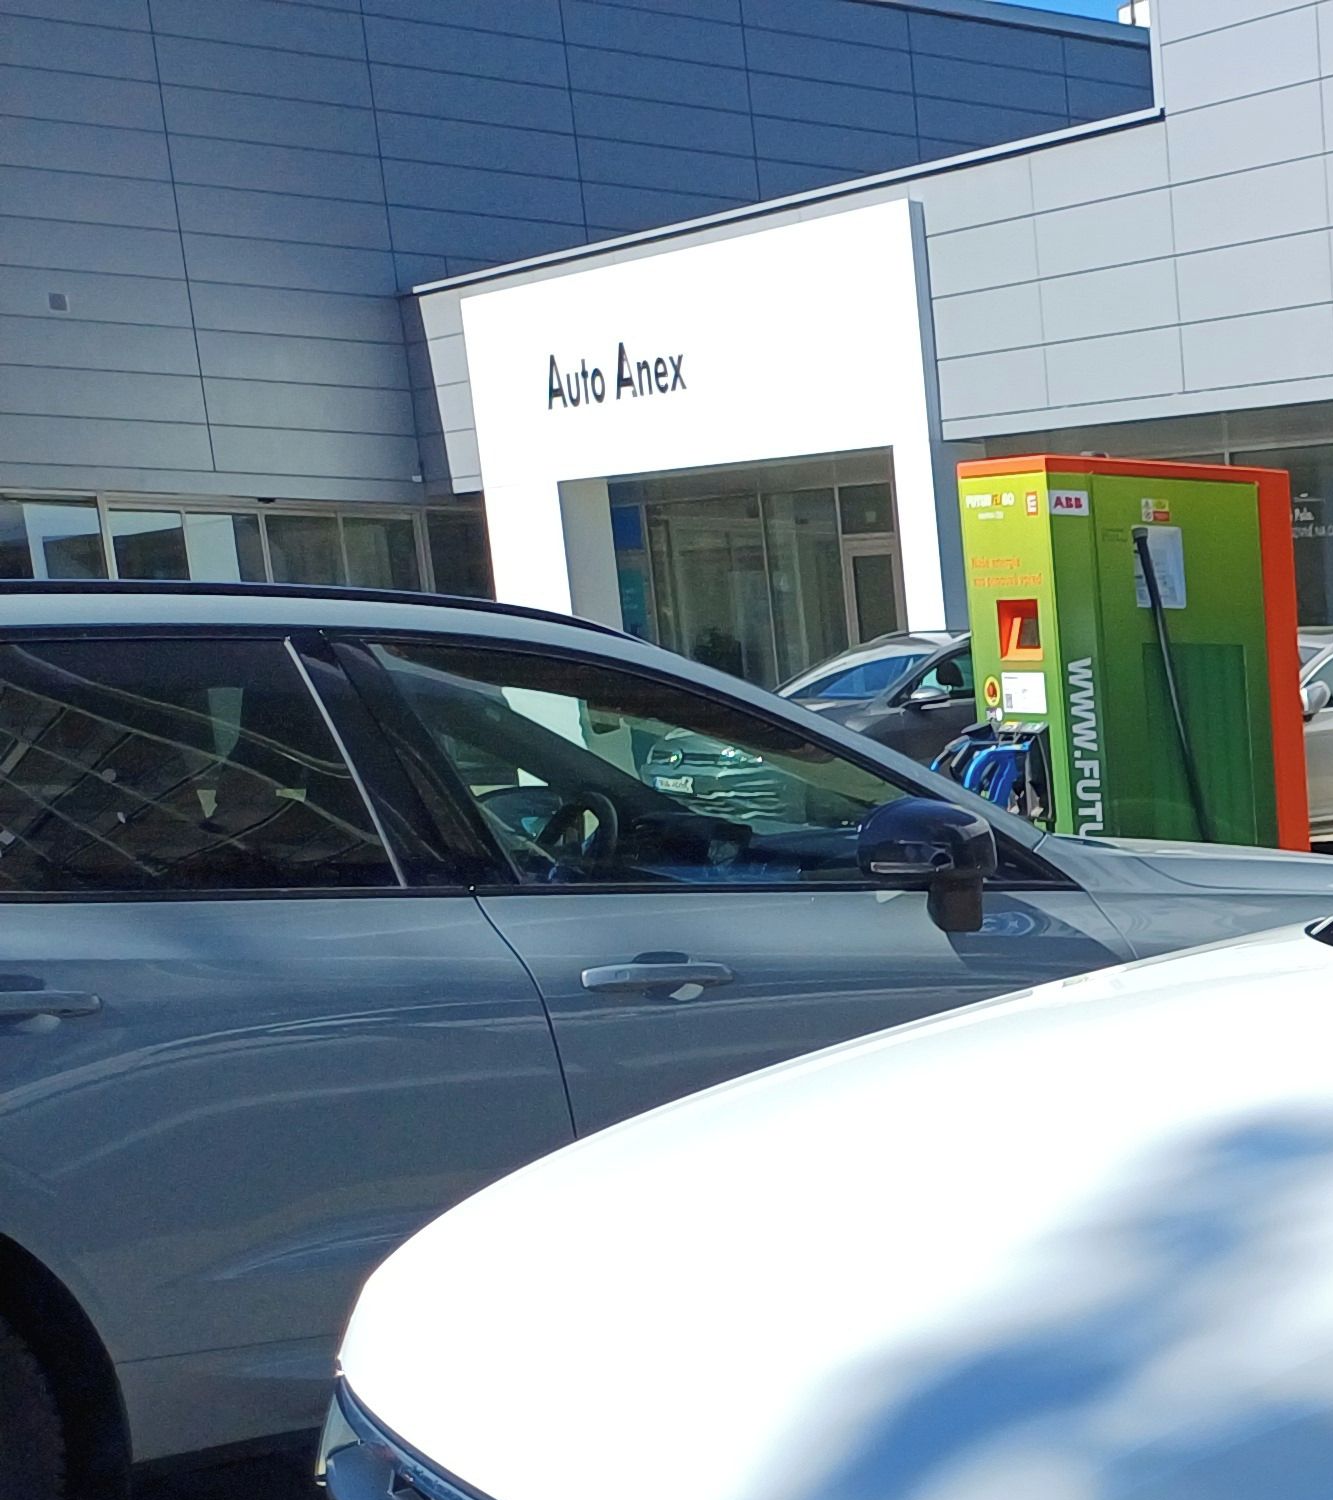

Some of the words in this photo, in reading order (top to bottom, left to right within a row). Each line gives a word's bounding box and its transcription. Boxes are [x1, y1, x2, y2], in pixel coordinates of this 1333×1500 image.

[548, 354, 606, 410] Auto
[615, 342, 687, 401] Anex
[1053, 495, 1084, 510] ABB
